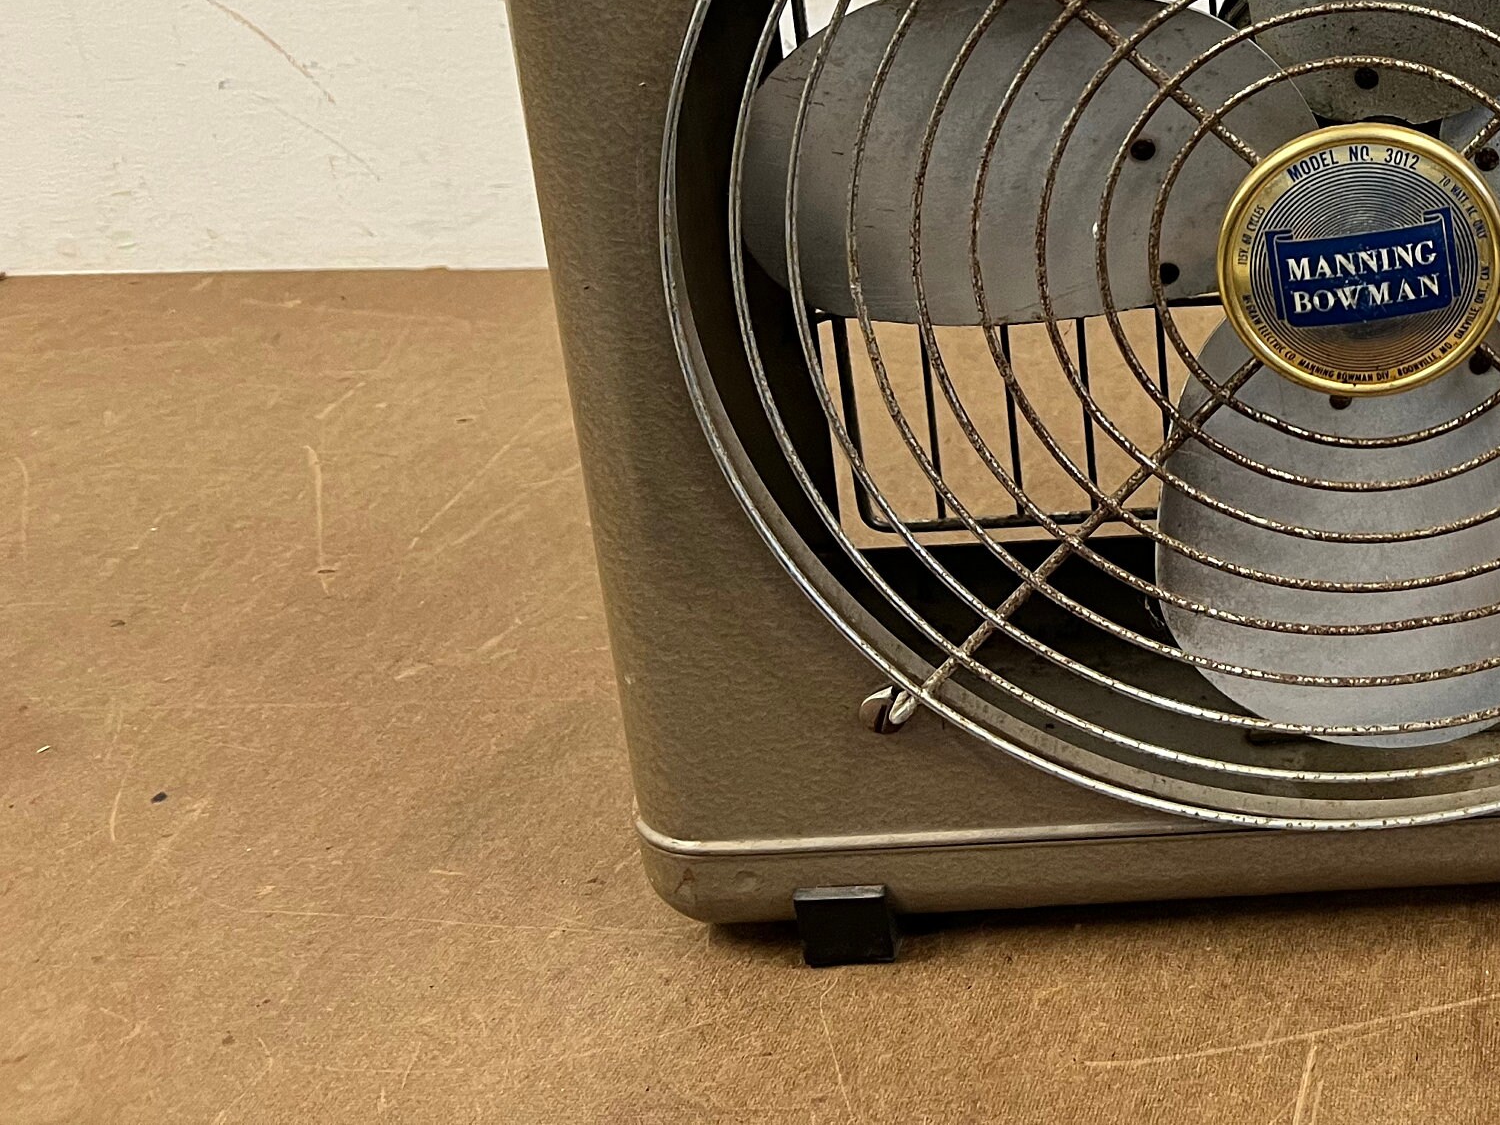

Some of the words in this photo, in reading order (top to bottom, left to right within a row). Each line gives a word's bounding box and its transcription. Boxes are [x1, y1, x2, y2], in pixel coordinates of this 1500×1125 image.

[1286, 149, 1339, 182] MODEL
[1348, 145, 1374, 161] NO.
[1384, 147, 1420, 170] 3012
[1246, 204, 1266, 232] CYCLES
[1439, 175, 1451, 187] 70
[1466, 205, 1478, 217] AC
[1472, 219, 1487, 240] ONLY
[1241, 233, 1252, 246] 60
[1286, 240, 1437, 282] MANNING
[1291, 273, 1440, 313] BOWMAN
[1258, 325, 1285, 353] ELECTRIC
[1298, 359, 1334, 378] MANNING
[1336, 372, 1374, 382] BOWMAN
